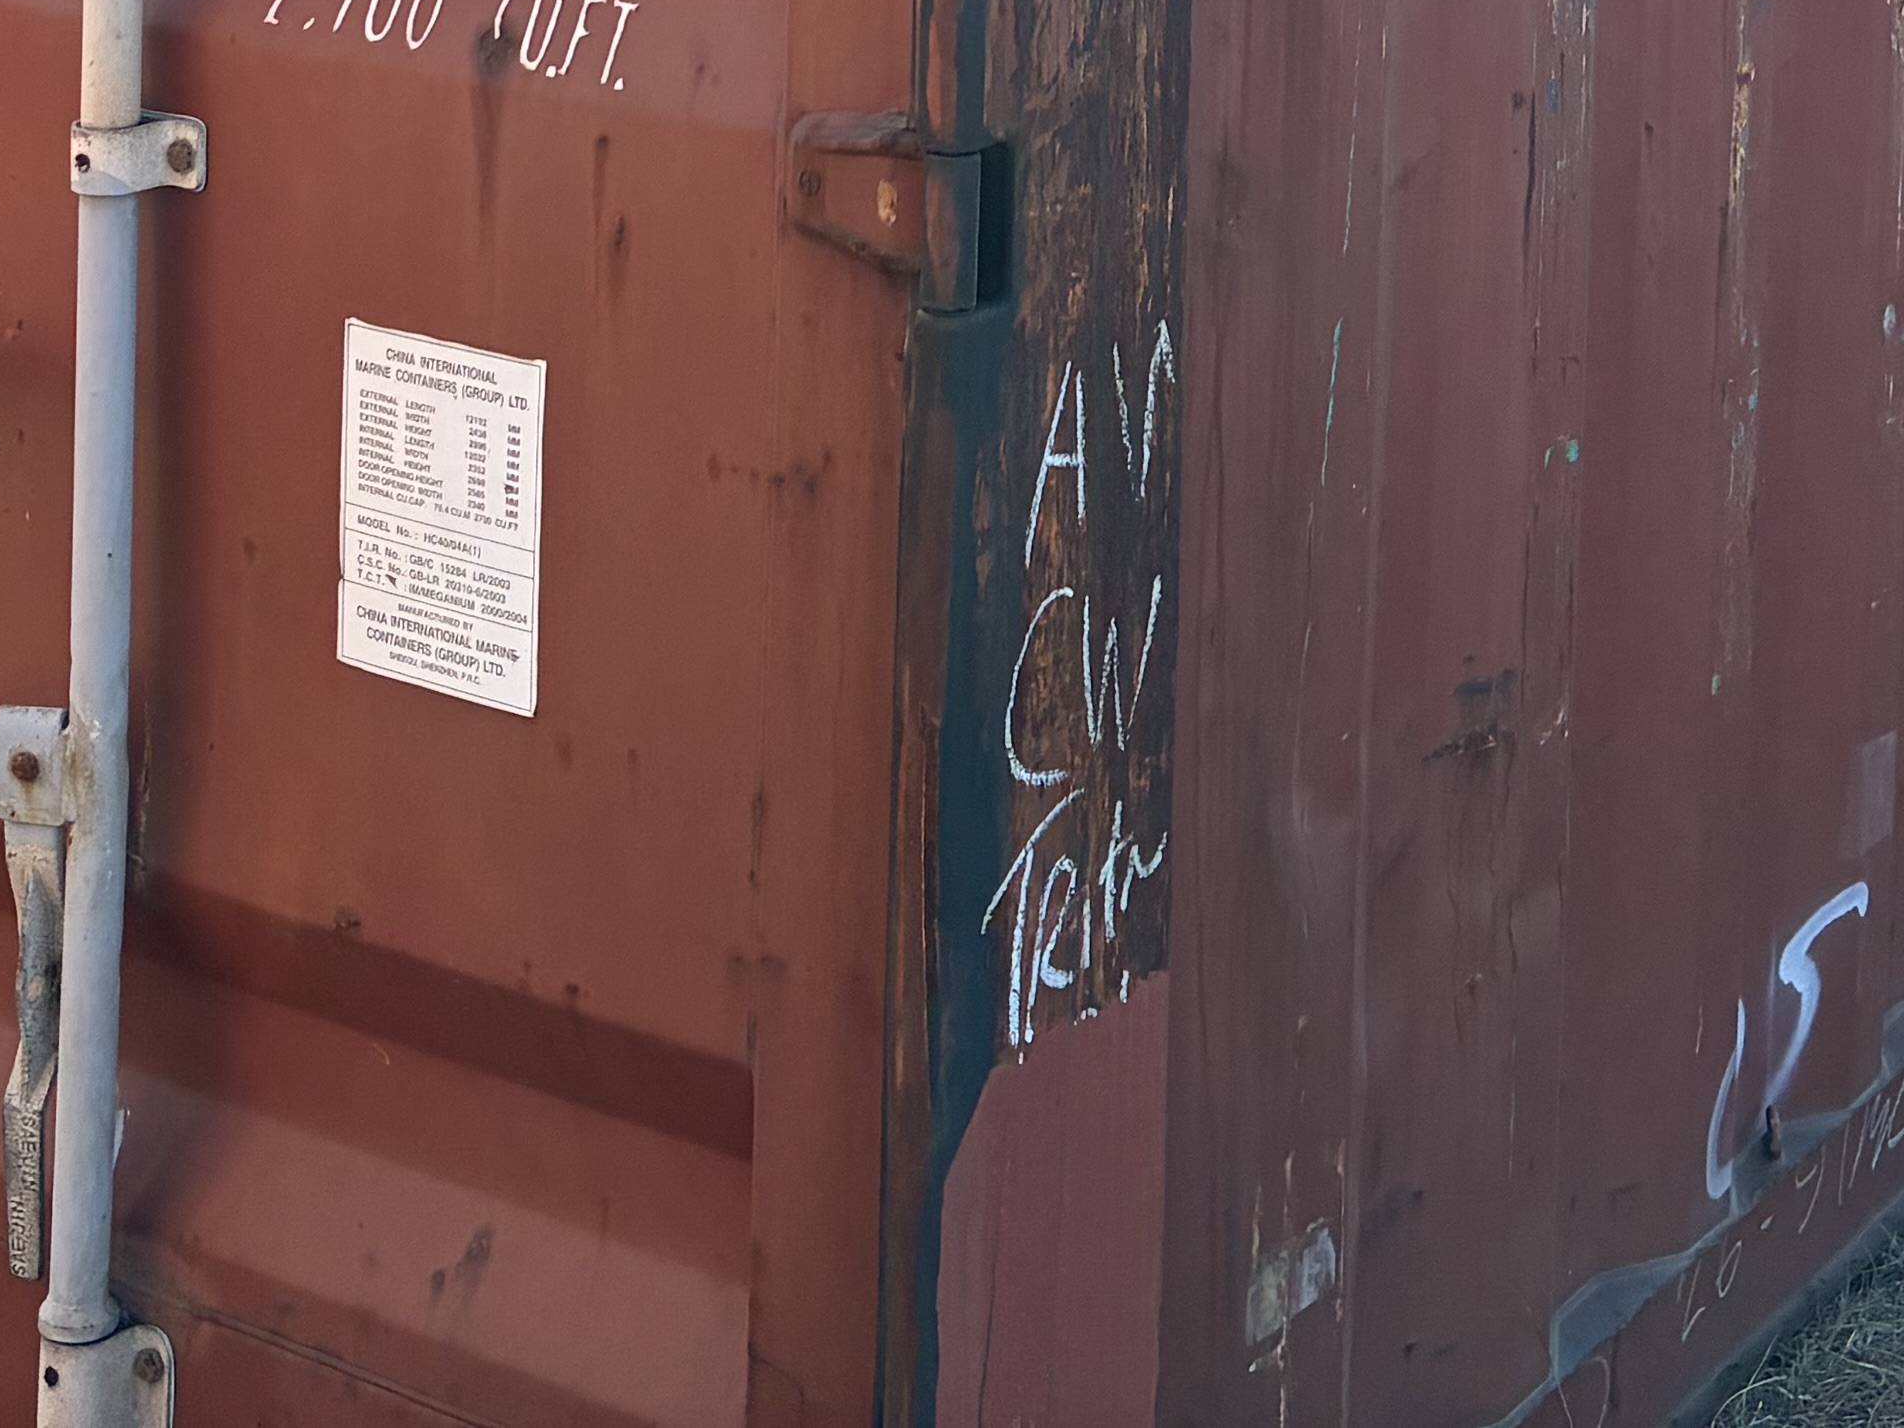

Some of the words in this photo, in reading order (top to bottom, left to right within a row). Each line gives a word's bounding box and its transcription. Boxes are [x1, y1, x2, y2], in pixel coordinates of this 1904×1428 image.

[355, 358, 391, 379] MARINE
[395, 368, 458, 395] CONTAINERS
[462, 384, 505, 408] (GROUP)
[508, 396, 531, 411] LTD.
[385, 347, 416, 366] CHINA
[420, 355, 498, 385] INTERNATIONAL
[357, 514, 391, 532] MODEL
[356, 605, 388, 626] CHINA
[390, 615, 473, 650] INTERNATIONAL
[475, 639, 520, 662] MARINE
[366, 626, 433, 657] CONTAINERS
[434, 647, 481, 672] (GROUP)
[482, 661, 507, 678] LTD.
